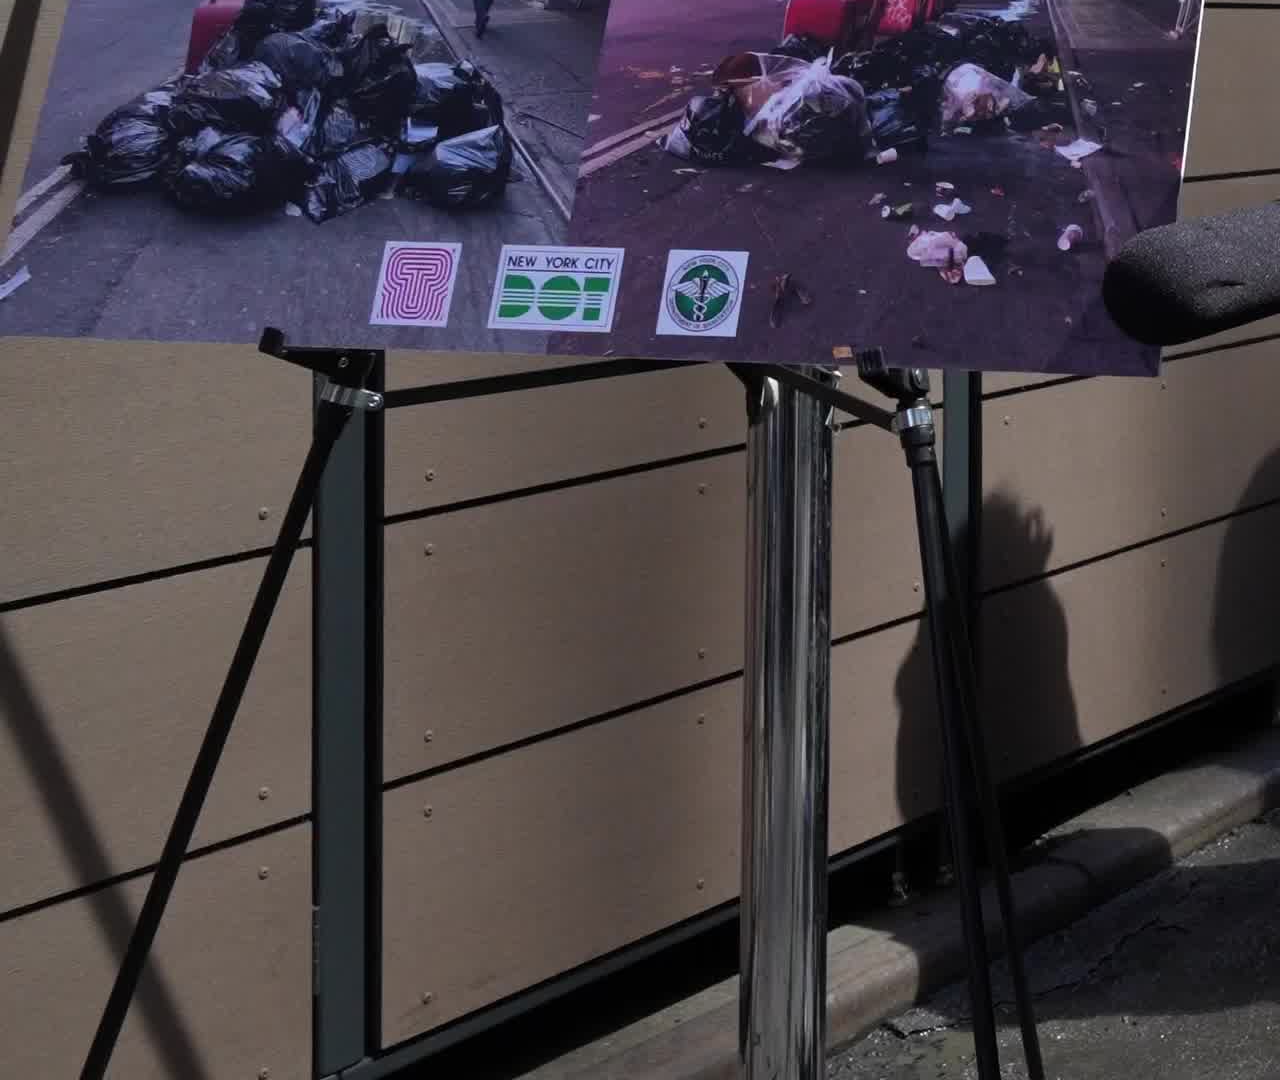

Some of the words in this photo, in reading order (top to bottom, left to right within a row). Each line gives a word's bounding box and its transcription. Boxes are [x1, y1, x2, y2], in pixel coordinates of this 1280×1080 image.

[507, 255, 537, 267] NEW
[545, 257, 579, 269] YORK
[584, 258, 615, 270] CITY
[497, 274, 611, 321] DOT
